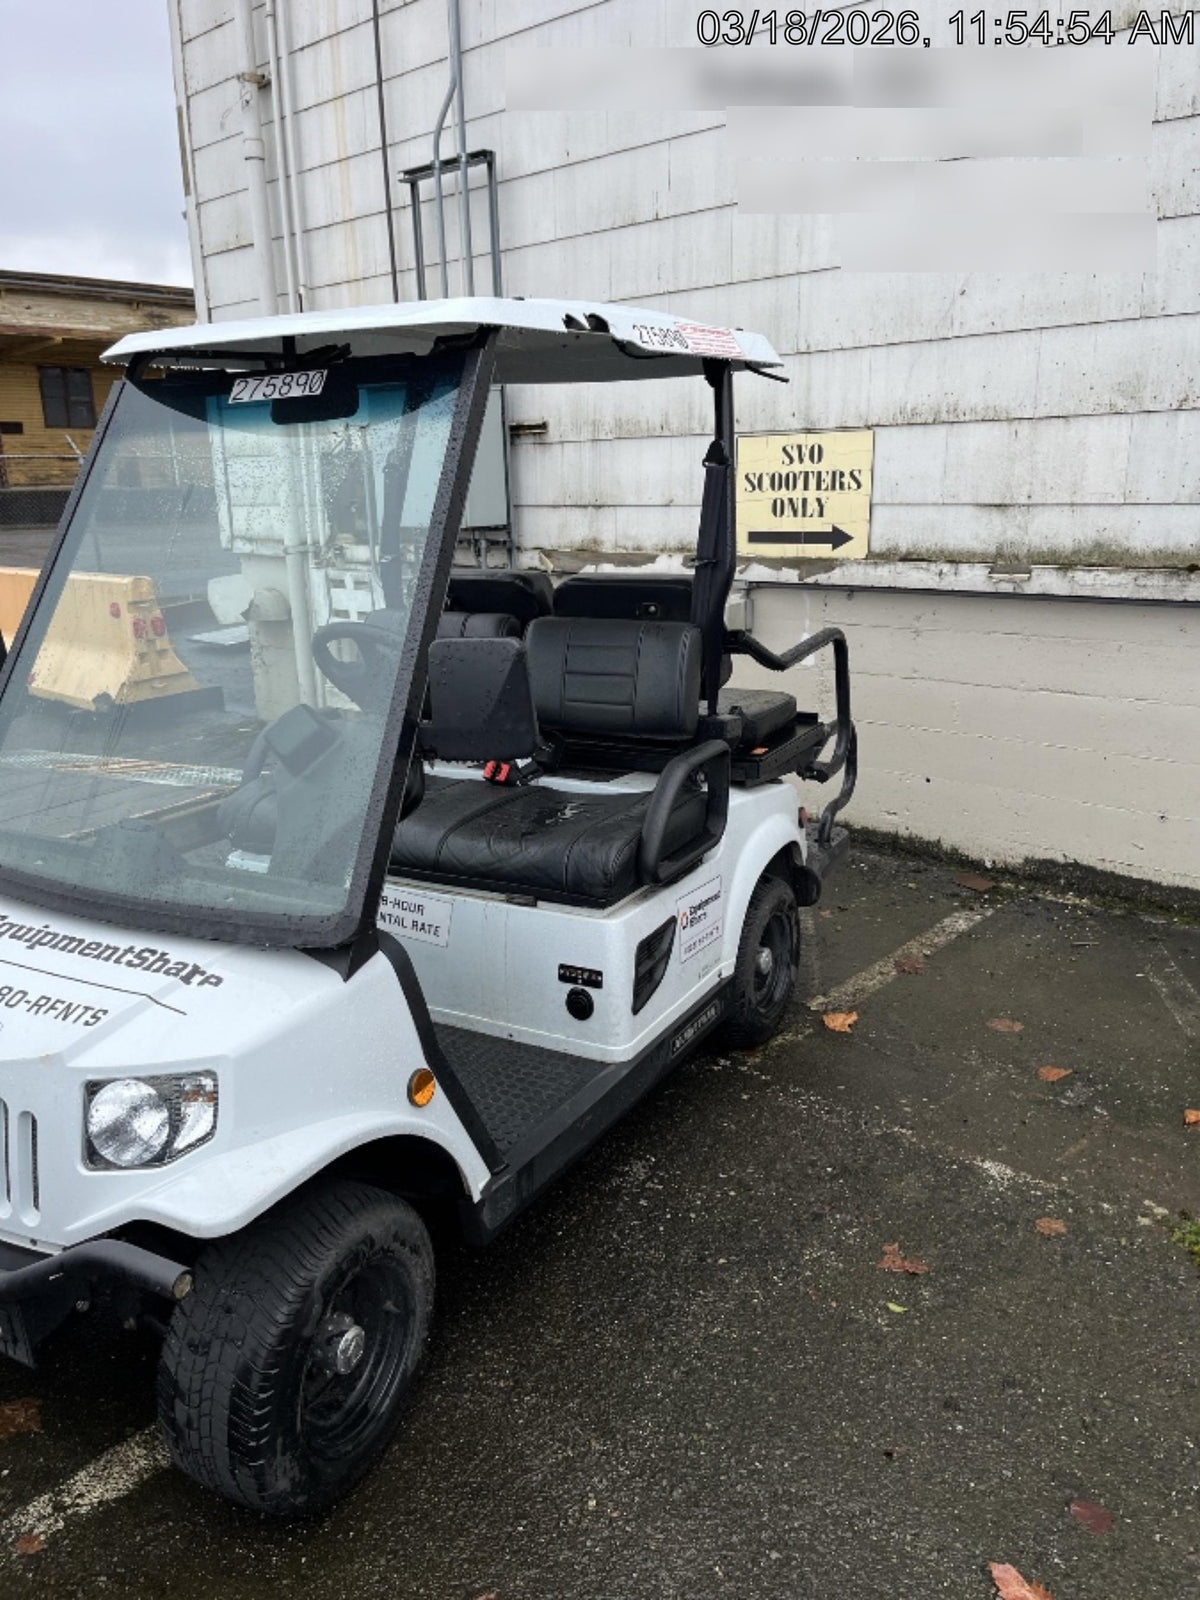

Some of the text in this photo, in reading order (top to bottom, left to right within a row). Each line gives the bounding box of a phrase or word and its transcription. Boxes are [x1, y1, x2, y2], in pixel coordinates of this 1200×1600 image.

[232, 371, 324, 400] 275890
[782, 443, 824, 466] SVO
[744, 469, 862, 493] SCOOTERS
[771, 497, 829, 518] ONLY
[380, 911, 441, 938] NTAL RATE
